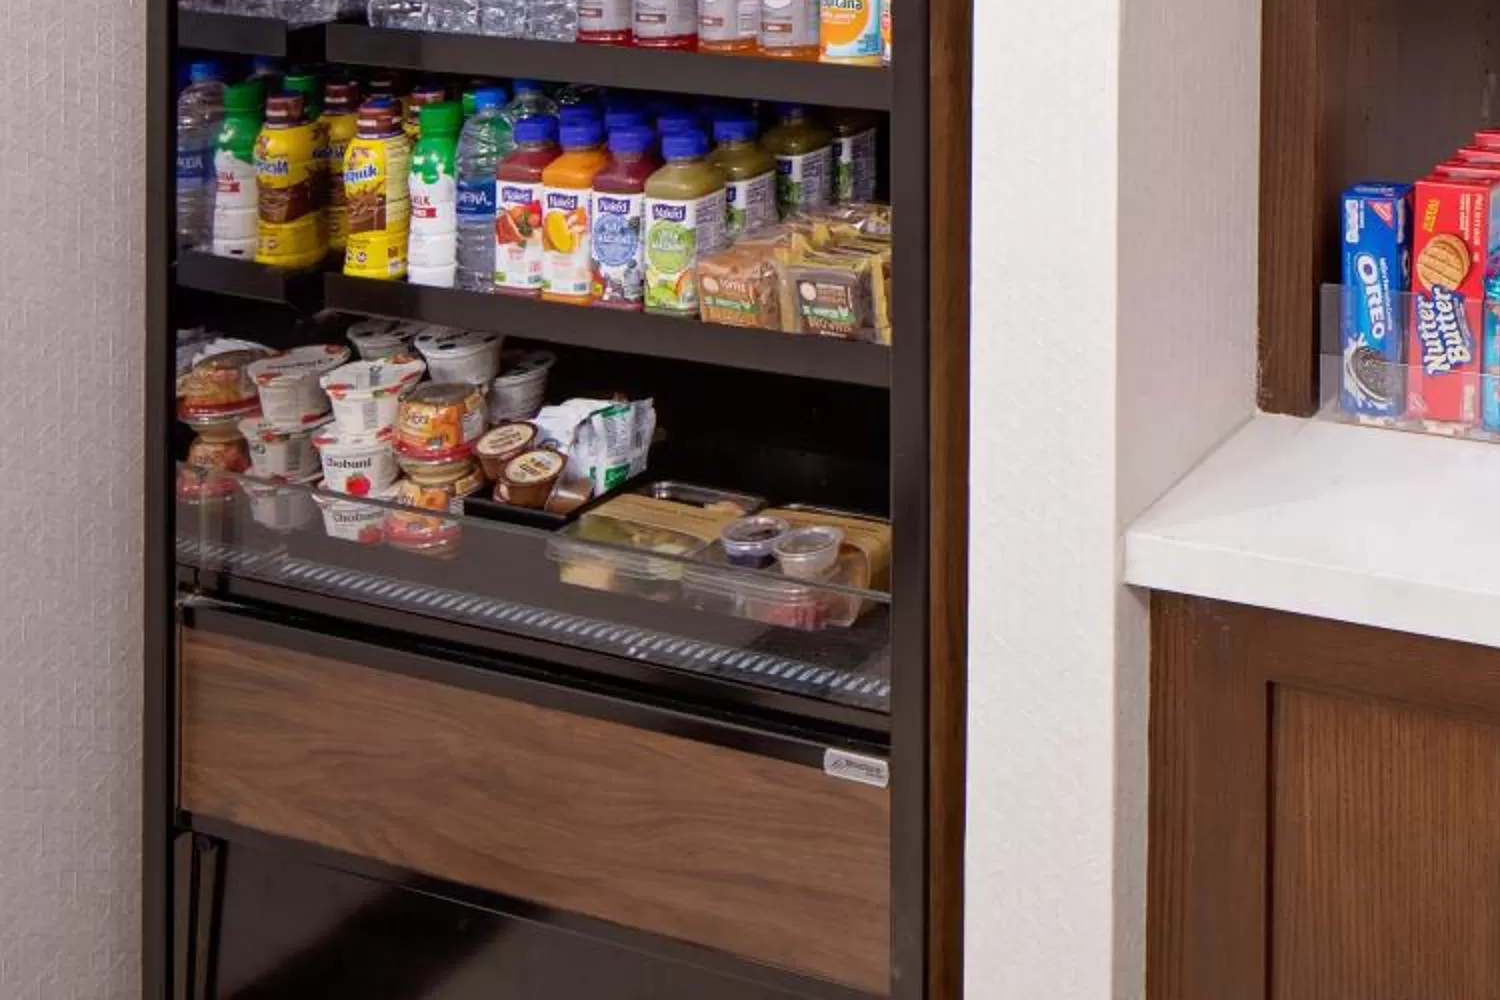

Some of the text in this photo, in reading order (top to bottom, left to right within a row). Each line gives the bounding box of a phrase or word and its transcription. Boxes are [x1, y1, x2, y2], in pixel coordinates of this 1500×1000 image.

[1357, 254, 1386, 339] OREO
[1415, 295, 1446, 376] Nutter
[1431, 285, 1472, 365] Butter
